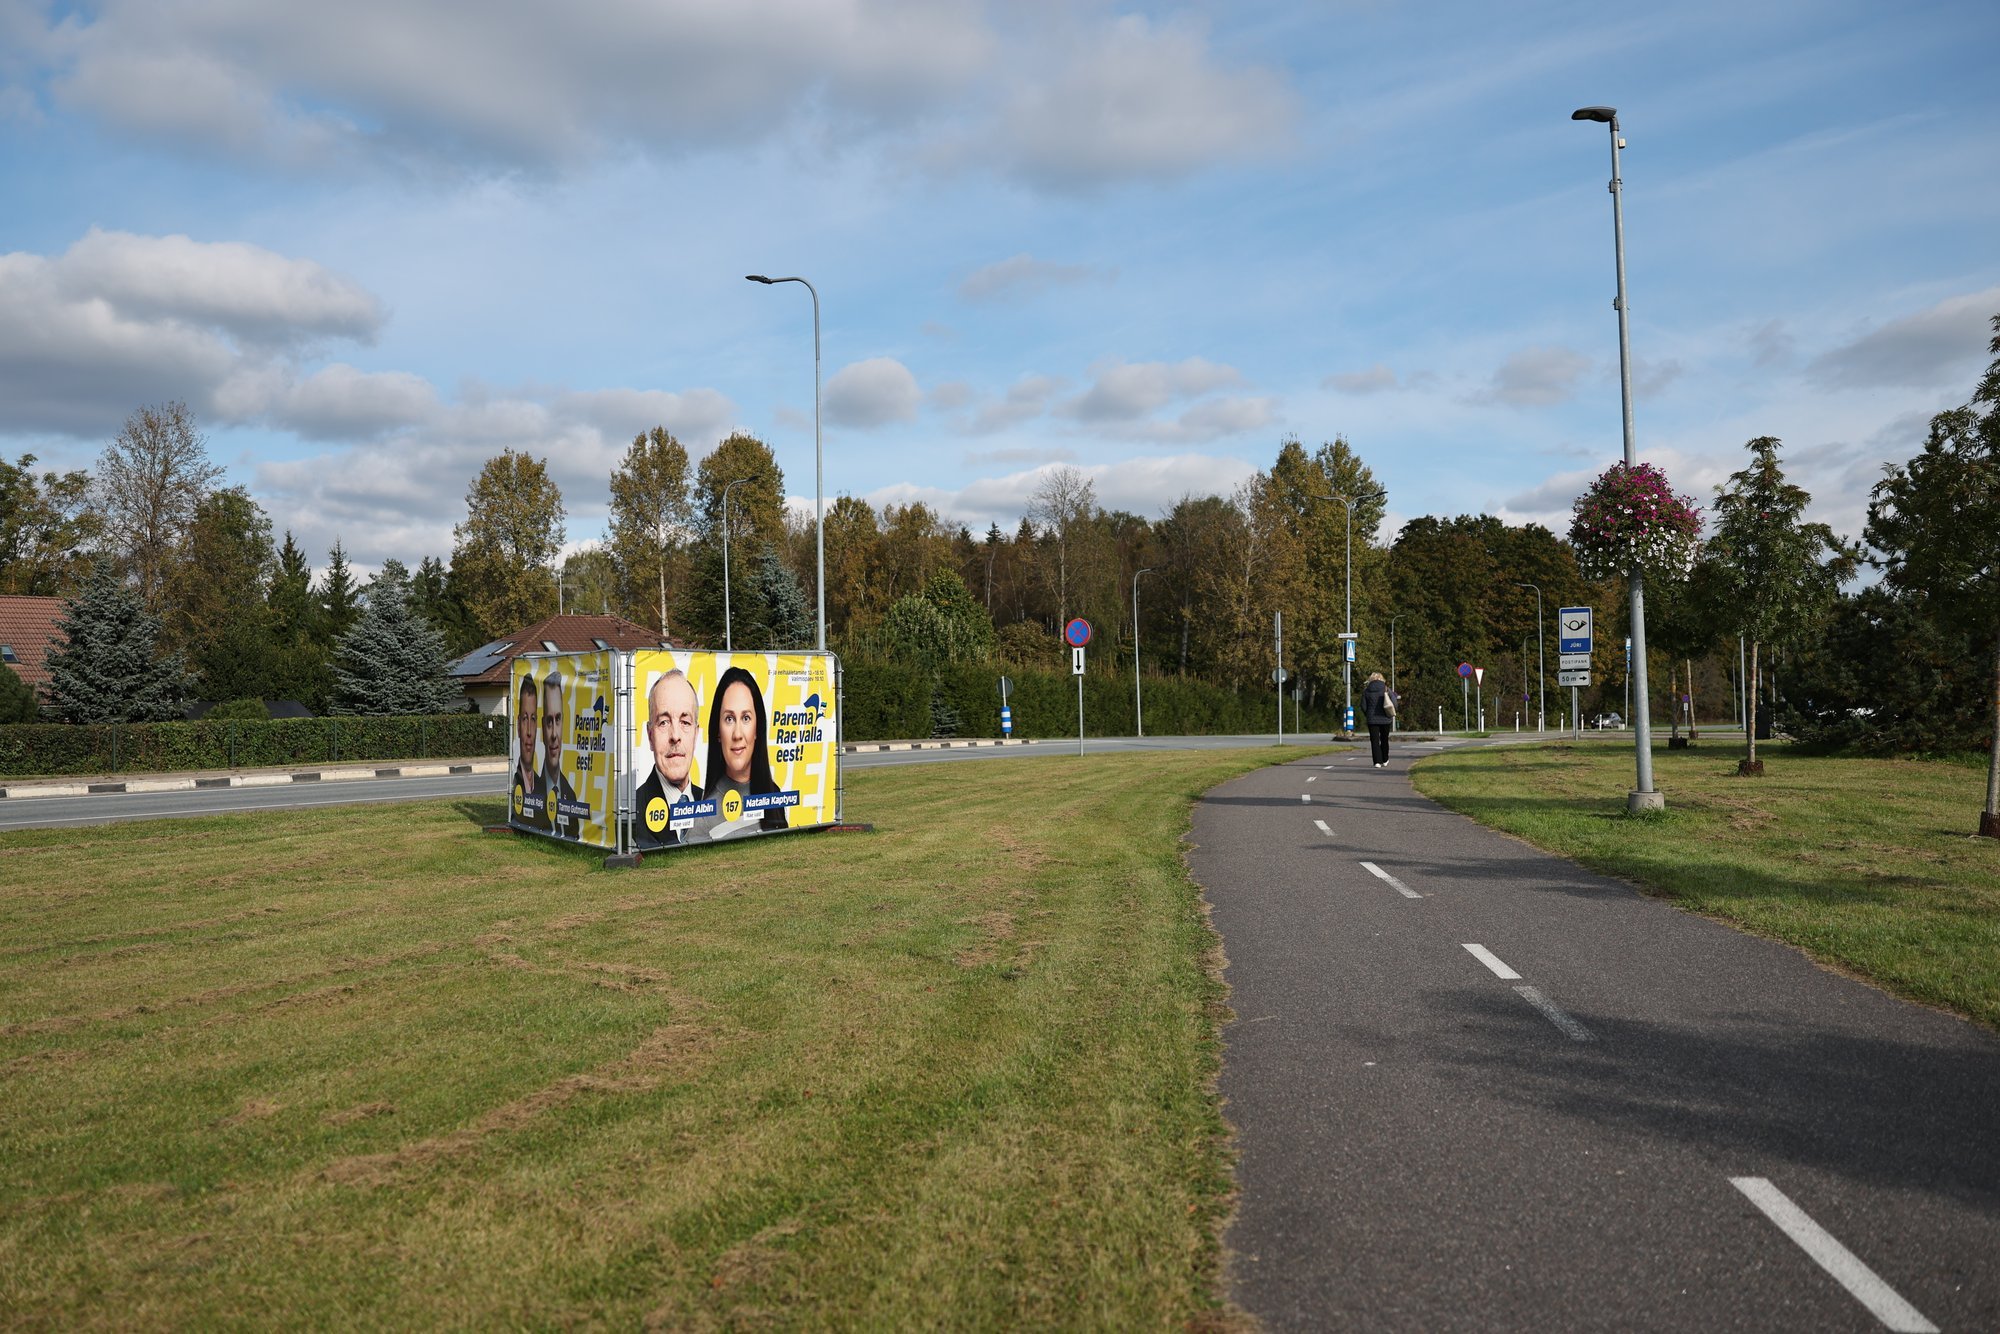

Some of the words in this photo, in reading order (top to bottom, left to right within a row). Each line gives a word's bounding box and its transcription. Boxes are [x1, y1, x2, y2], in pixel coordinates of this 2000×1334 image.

[575, 714, 599, 731] Parema
[773, 711, 814, 726] Parema
[576, 733, 589, 750] Rae
[590, 732, 606, 751] valla
[776, 728, 797, 744] Rae
[799, 726, 822, 743] valla
[776, 745, 804, 763] eest!
[576, 753, 593, 771] eest!
[558, 802, 570, 812] Tarmo
[725, 801, 739, 812] 157
[746, 795, 770, 808] Natalia
[648, 809, 665, 822] 166
[673, 804, 694, 817] Endel
[695, 803, 714, 814] Albin
